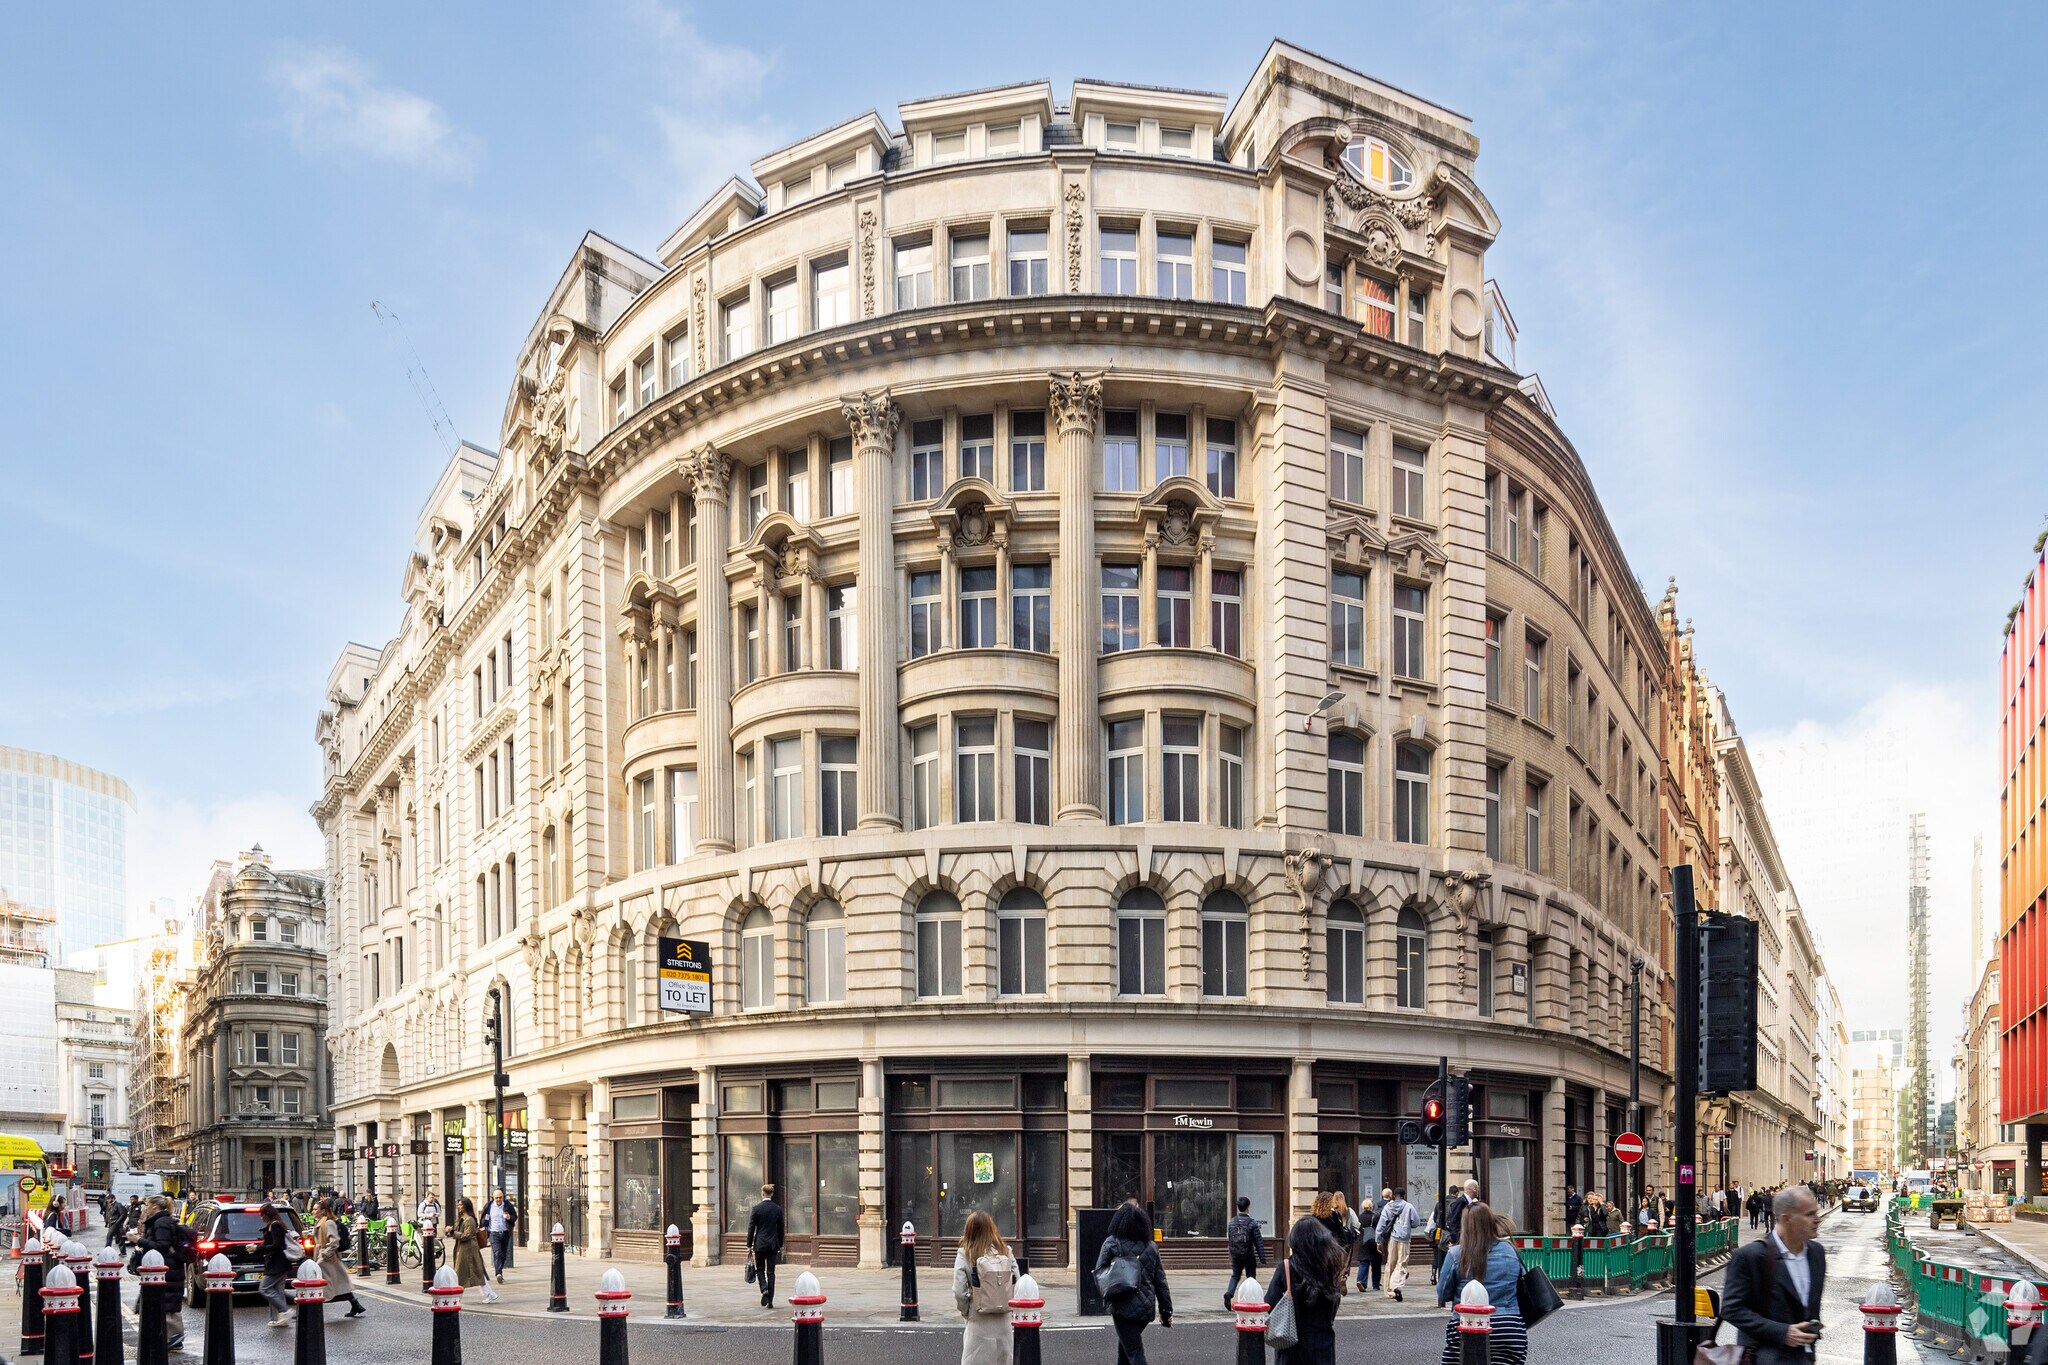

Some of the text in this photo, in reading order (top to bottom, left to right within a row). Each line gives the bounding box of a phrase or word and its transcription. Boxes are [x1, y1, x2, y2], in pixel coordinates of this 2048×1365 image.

[667, 959, 702, 969] STRETTONS
[665, 990, 706, 1003] TO LET
[1189, 1117, 1213, 1129] Lewin
